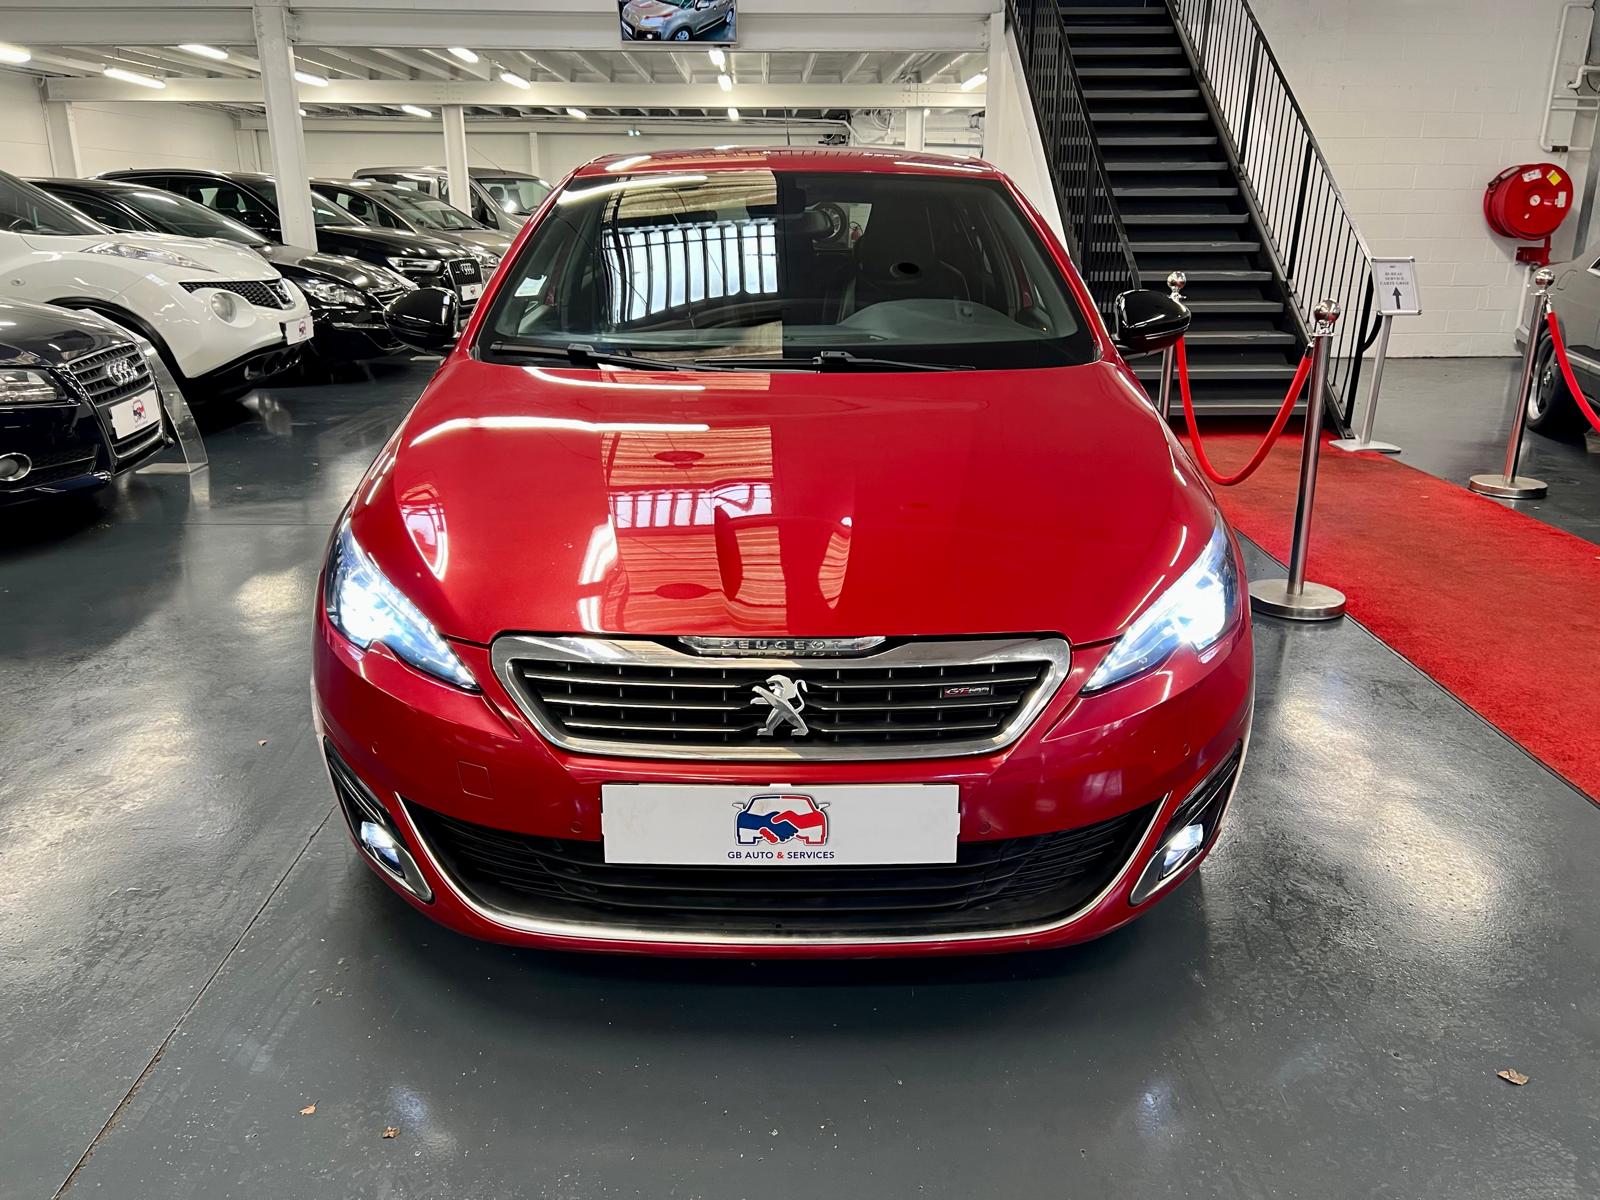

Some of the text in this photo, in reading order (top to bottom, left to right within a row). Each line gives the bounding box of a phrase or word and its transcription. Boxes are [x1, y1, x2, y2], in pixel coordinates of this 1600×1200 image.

[719, 639, 844, 650] PEUGEOT
[727, 851, 835, 859] GB AUTO & SERVICES
